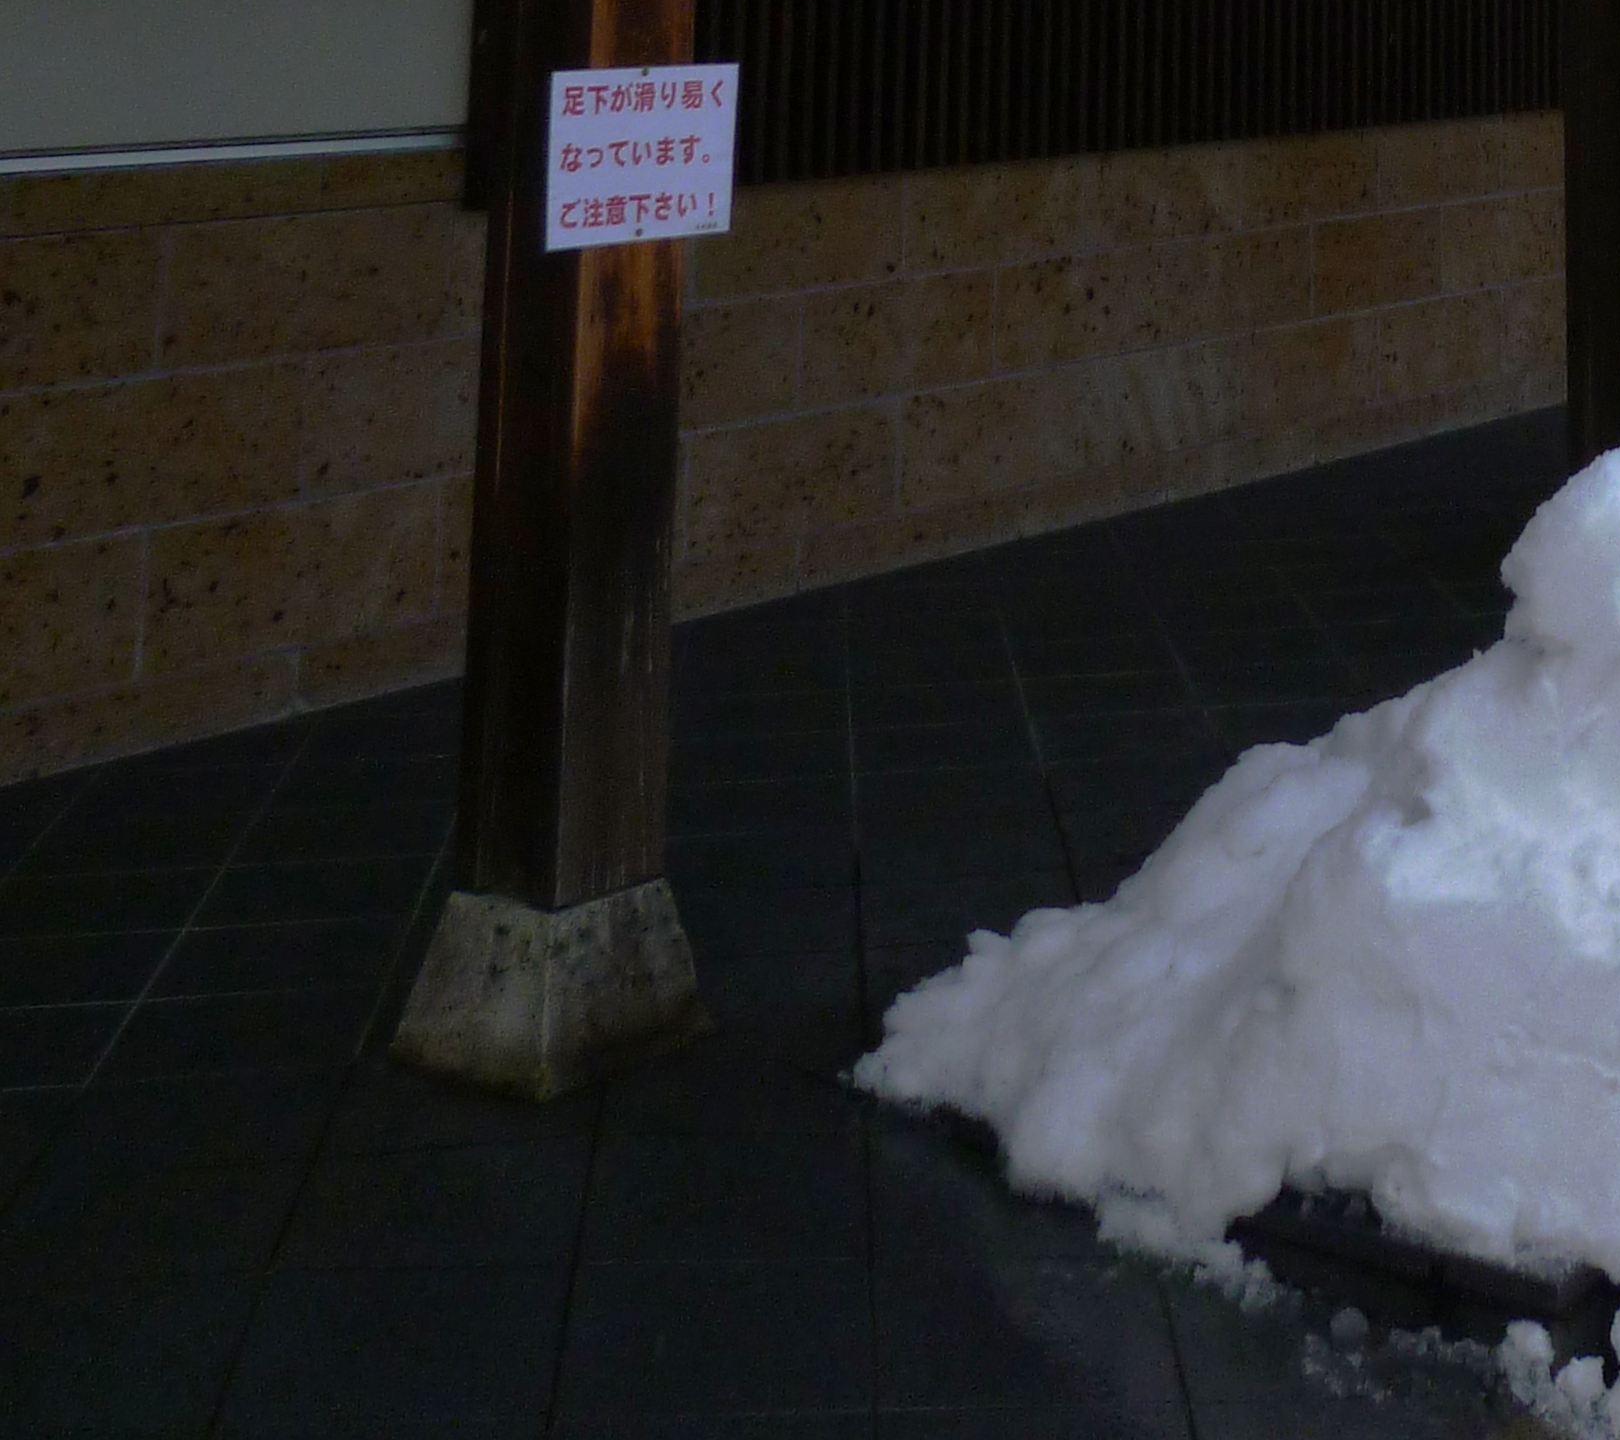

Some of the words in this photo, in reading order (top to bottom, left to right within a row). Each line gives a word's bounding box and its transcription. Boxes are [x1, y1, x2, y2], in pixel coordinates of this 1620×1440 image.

[563, 80, 724, 116] 足下が滑り易く
[560, 134, 711, 172] なっています。
[559, 192, 715, 229] ご注意下さい！
